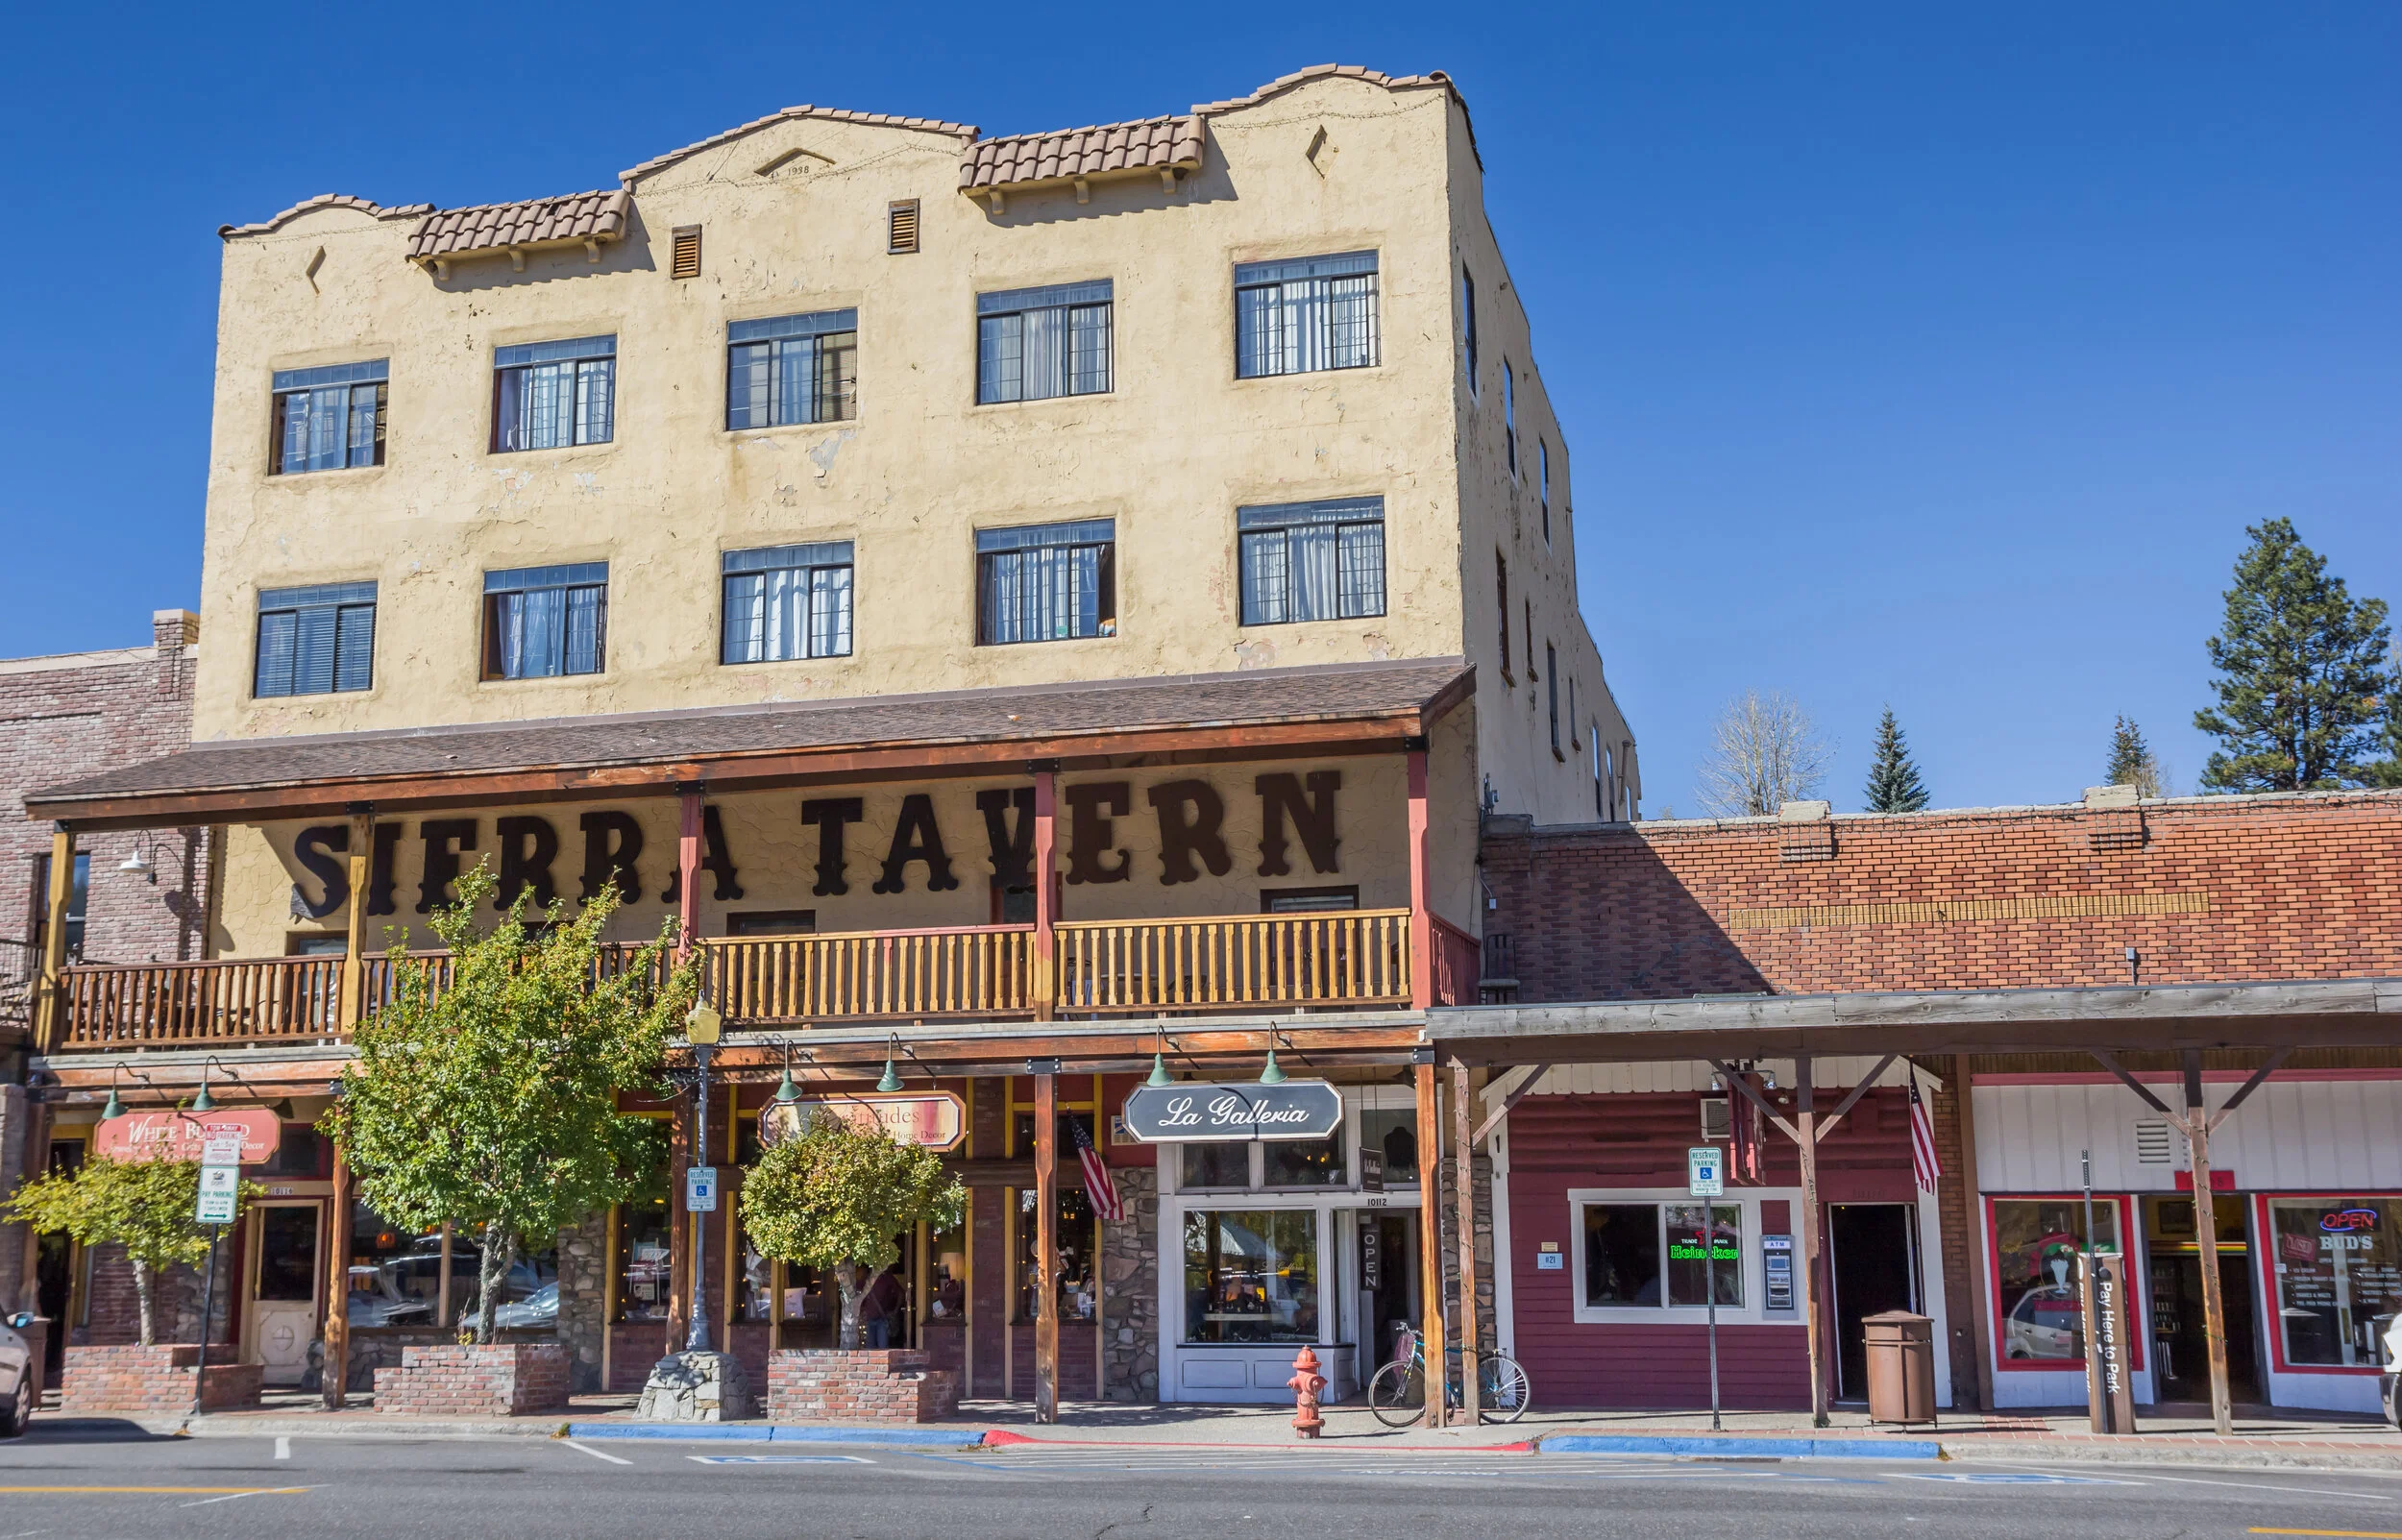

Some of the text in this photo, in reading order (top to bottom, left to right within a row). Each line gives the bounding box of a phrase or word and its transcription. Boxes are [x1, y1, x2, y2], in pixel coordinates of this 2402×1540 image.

[290, 770, 1341, 920] SIERRA TAVERN
[1158, 1095, 1310, 1127] La Galleria
[920, 1131, 946, 1140] Decor
[2323, 1213, 2374, 1228] OPEN
[2319, 1235, 2374, 1250] BUD'S
[1364, 1234, 1377, 1286] OPEN
[2098, 1282, 2121, 1394] Pay Here to Park
